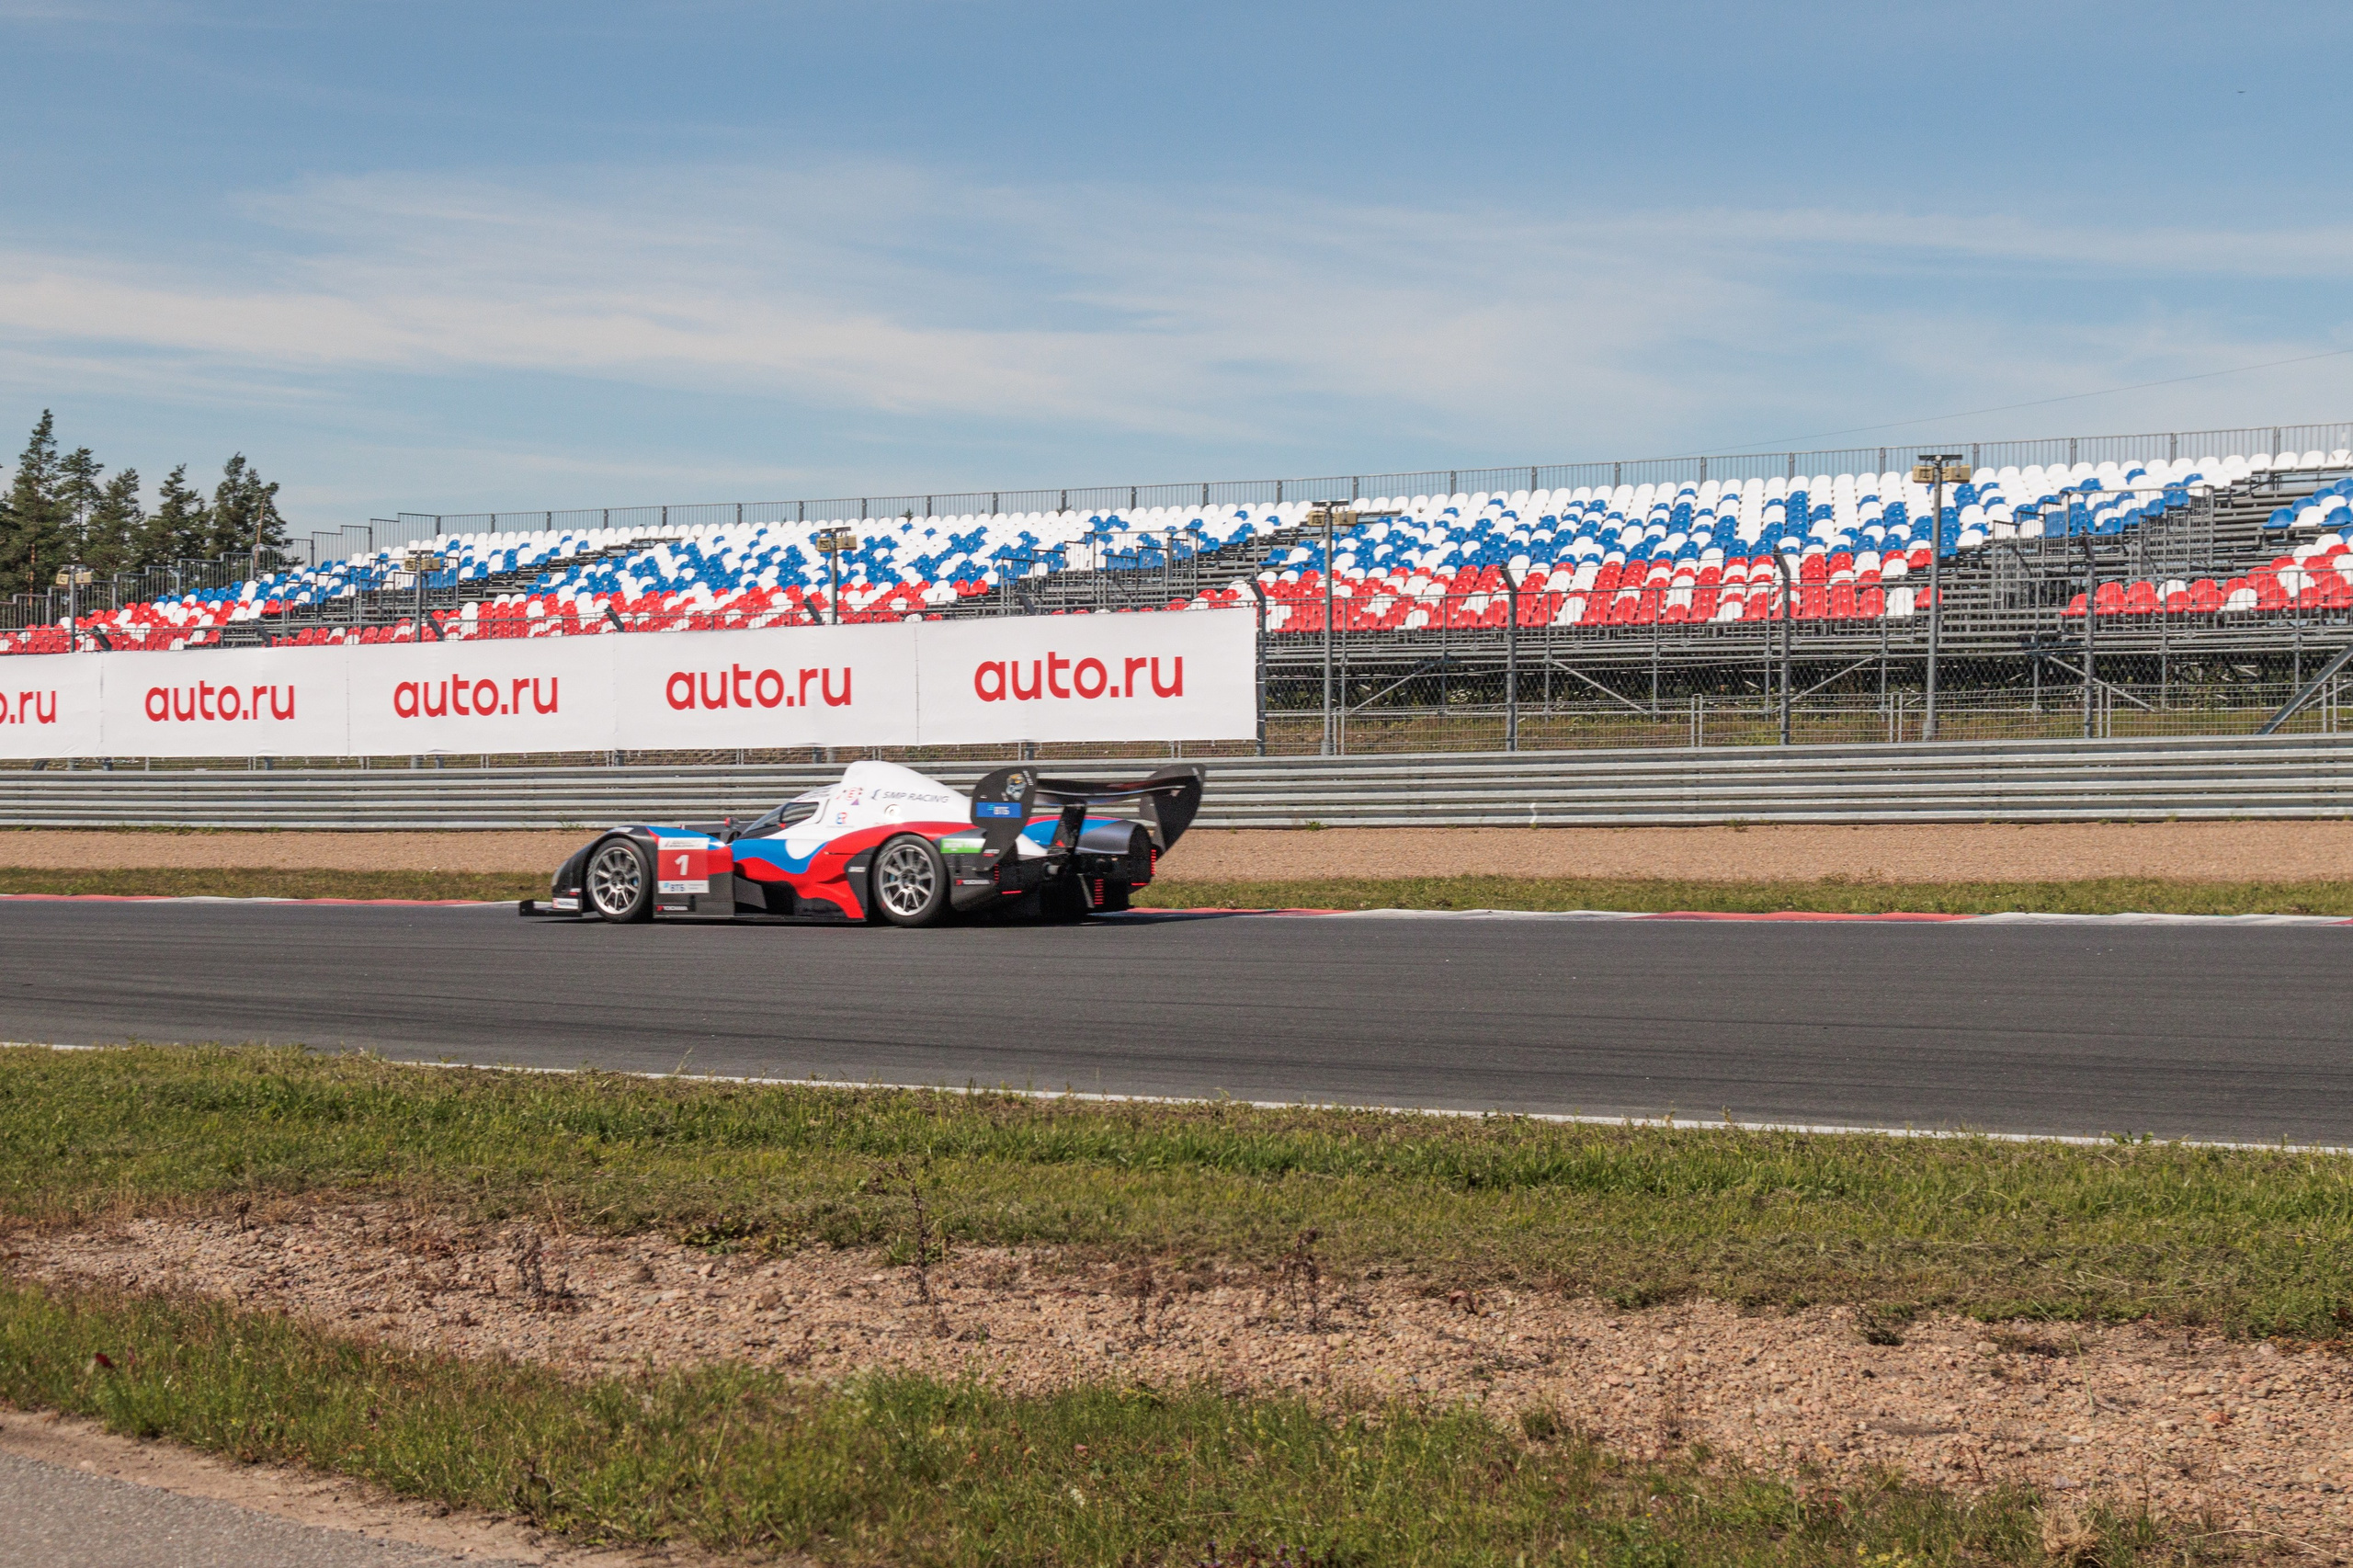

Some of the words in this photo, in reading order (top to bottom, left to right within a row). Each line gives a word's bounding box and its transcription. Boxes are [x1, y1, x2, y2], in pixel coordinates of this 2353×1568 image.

[392, 673, 559, 719] auto.ru
[665, 663, 852, 711] auto.ru
[973, 651, 1184, 703] auto.ru
[144, 680, 295, 722] auto.ru
[908, 792, 950, 803] RACING
[675, 854, 689, 876] 1
